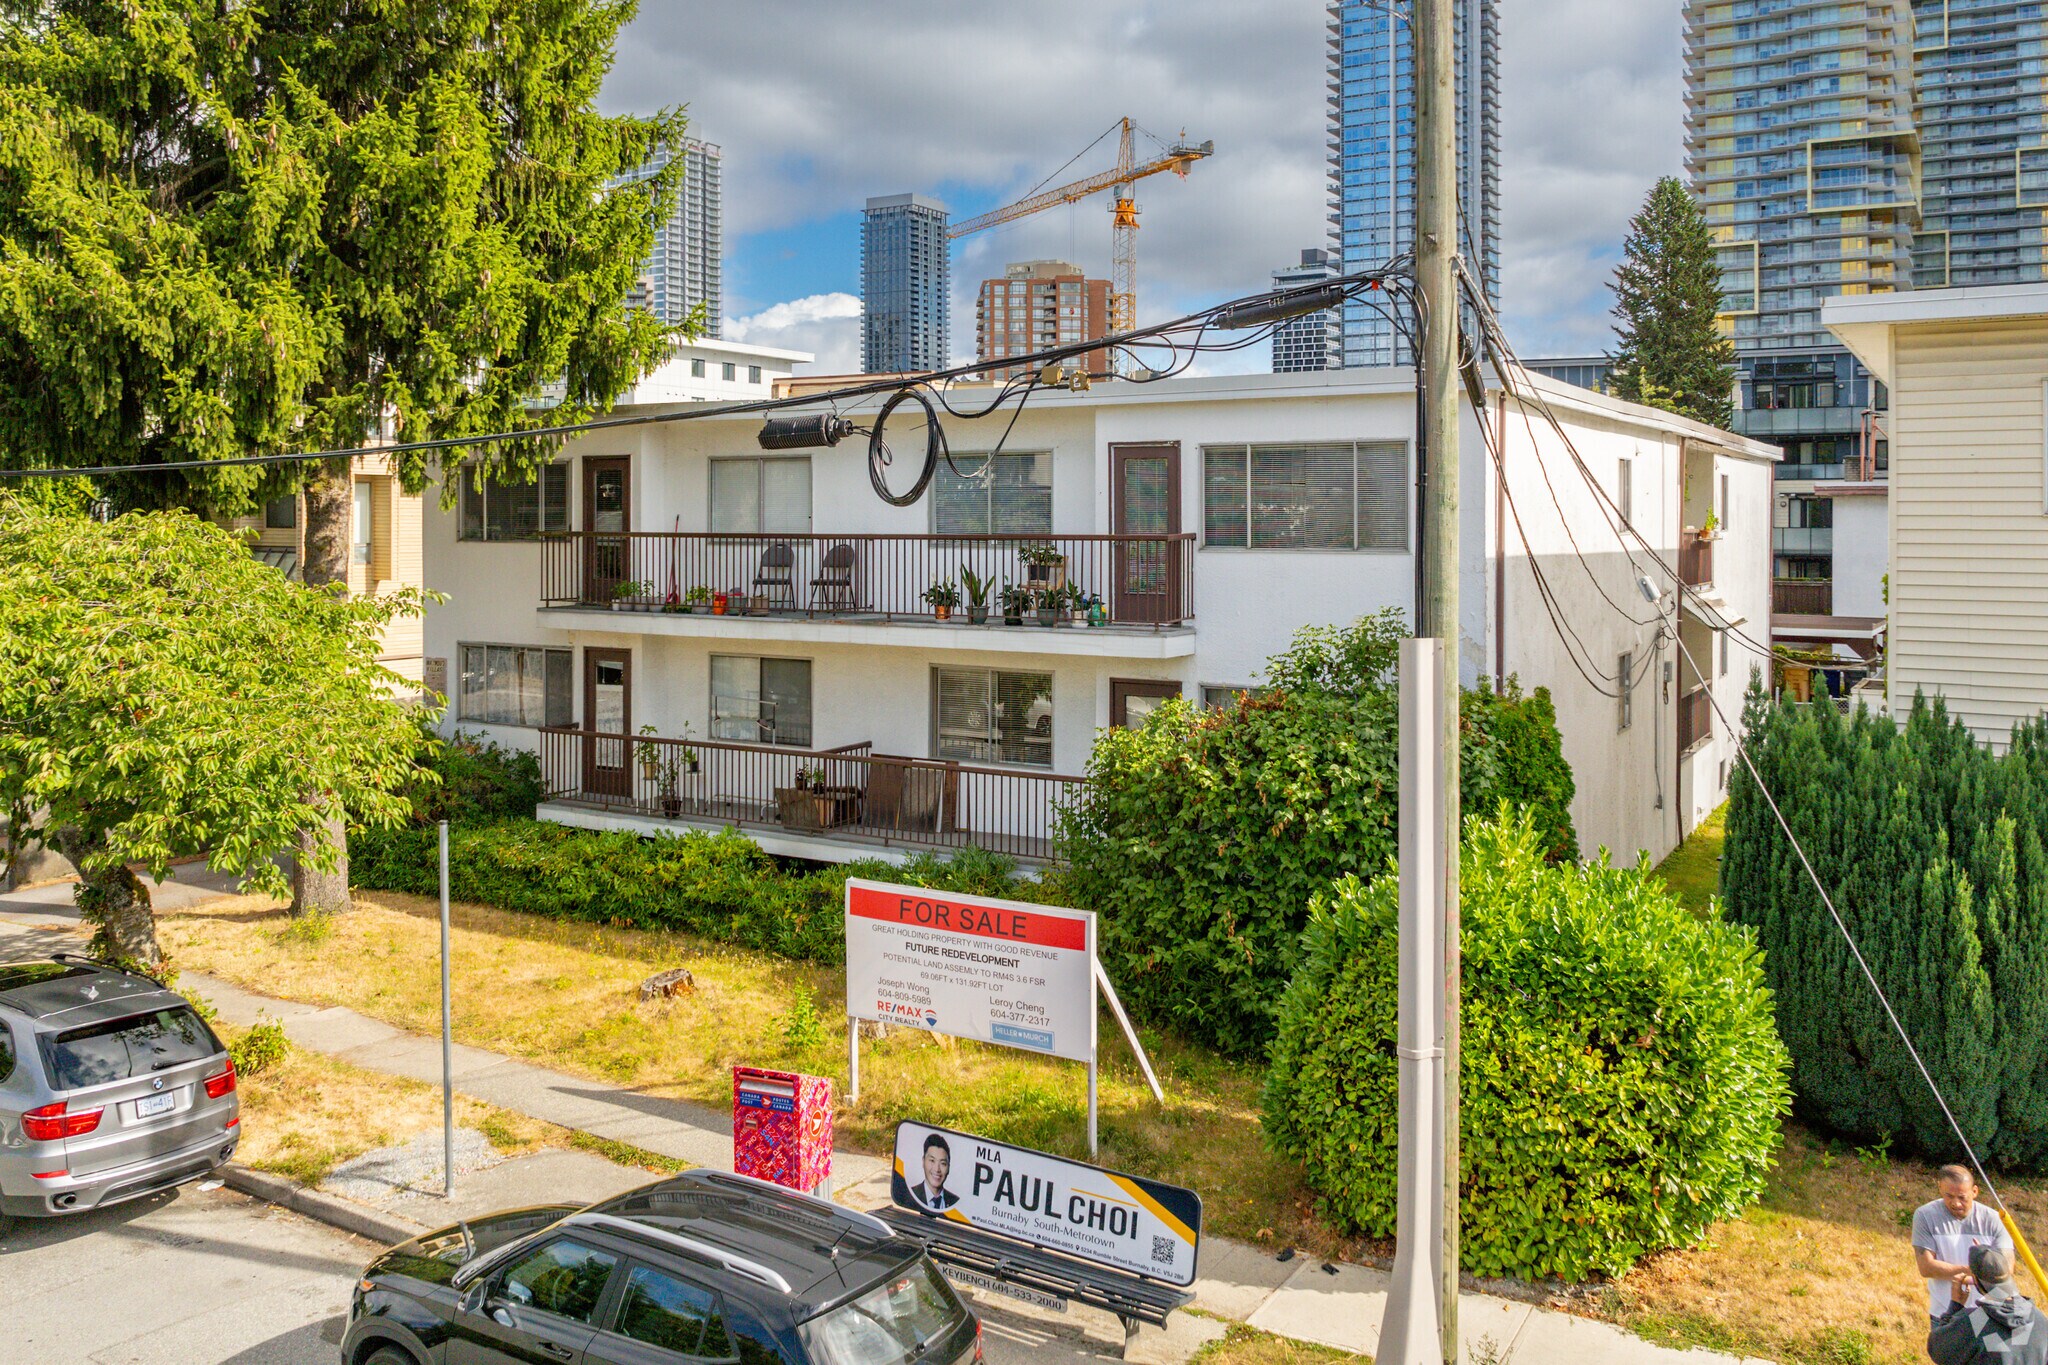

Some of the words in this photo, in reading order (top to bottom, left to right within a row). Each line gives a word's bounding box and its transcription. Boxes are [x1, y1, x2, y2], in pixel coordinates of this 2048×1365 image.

[900, 899, 950, 927] FOR
[960, 908, 1026, 938] SALE
[872, 924, 895, 934] GREAT
[897, 928, 930, 940] HOLDING
[931, 933, 971, 947] PROPERTY
[973, 941, 993, 951] WITH
[995, 943, 1018, 955] GOOD
[1020, 947, 1059, 960] REVENUE
[905, 941, 939, 956] FUTURE
[941, 947, 1020, 968] REDEVELOPMENT
[883, 952, 922, 966] POTENTIAL
[923, 959, 943, 970] LAND
[980, 969, 991, 978] TO
[993, 970, 1015, 982] RM4S
[1016, 975, 1028, 984] 3.6
[1029, 977, 1046, 987] FSR
[878, 976, 905, 989] Joseph
[907, 981, 930, 995] Wong
[920, 971, 948, 982] 69.06FT
[956, 977, 987, 989] 131.92FT
[988, 983, 1004, 992] LOT
[878, 987, 931, 1006] 604-809-5989
[990, 995, 1014, 1010] Leroy
[1016, 1000, 1045, 1015] Cheng
[877, 1000, 922, 1018] RE/MAX
[878, 1013, 893, 1021] CITY
[895, 1016, 920, 1026] REALTY
[990, 1008, 1050, 1026] 604-377-2317
[995, 1026, 1018, 1037] HELLER
[1023, 1031, 1049, 1043] MURCH
[976, 1146, 1002, 1164] MLA
[972, 1161, 1062, 1220] PAUL
[1068, 1194, 1138, 1240] CHOI
[991, 1205, 1029, 1227] Burnaby
[1034, 1217, 1115, 1249] South-Metrotown
[1093, 1250, 1112, 1260] Rumble
[1113, 1256, 1127, 1265] Street
[1128, 1259, 1150, 1272] Burnaby,
[1151, 1266, 1162, 1274] B.C.
[942, 1266, 990, 1289] KEYBENCH
[992, 1282, 1062, 1310] 604-533-2000
